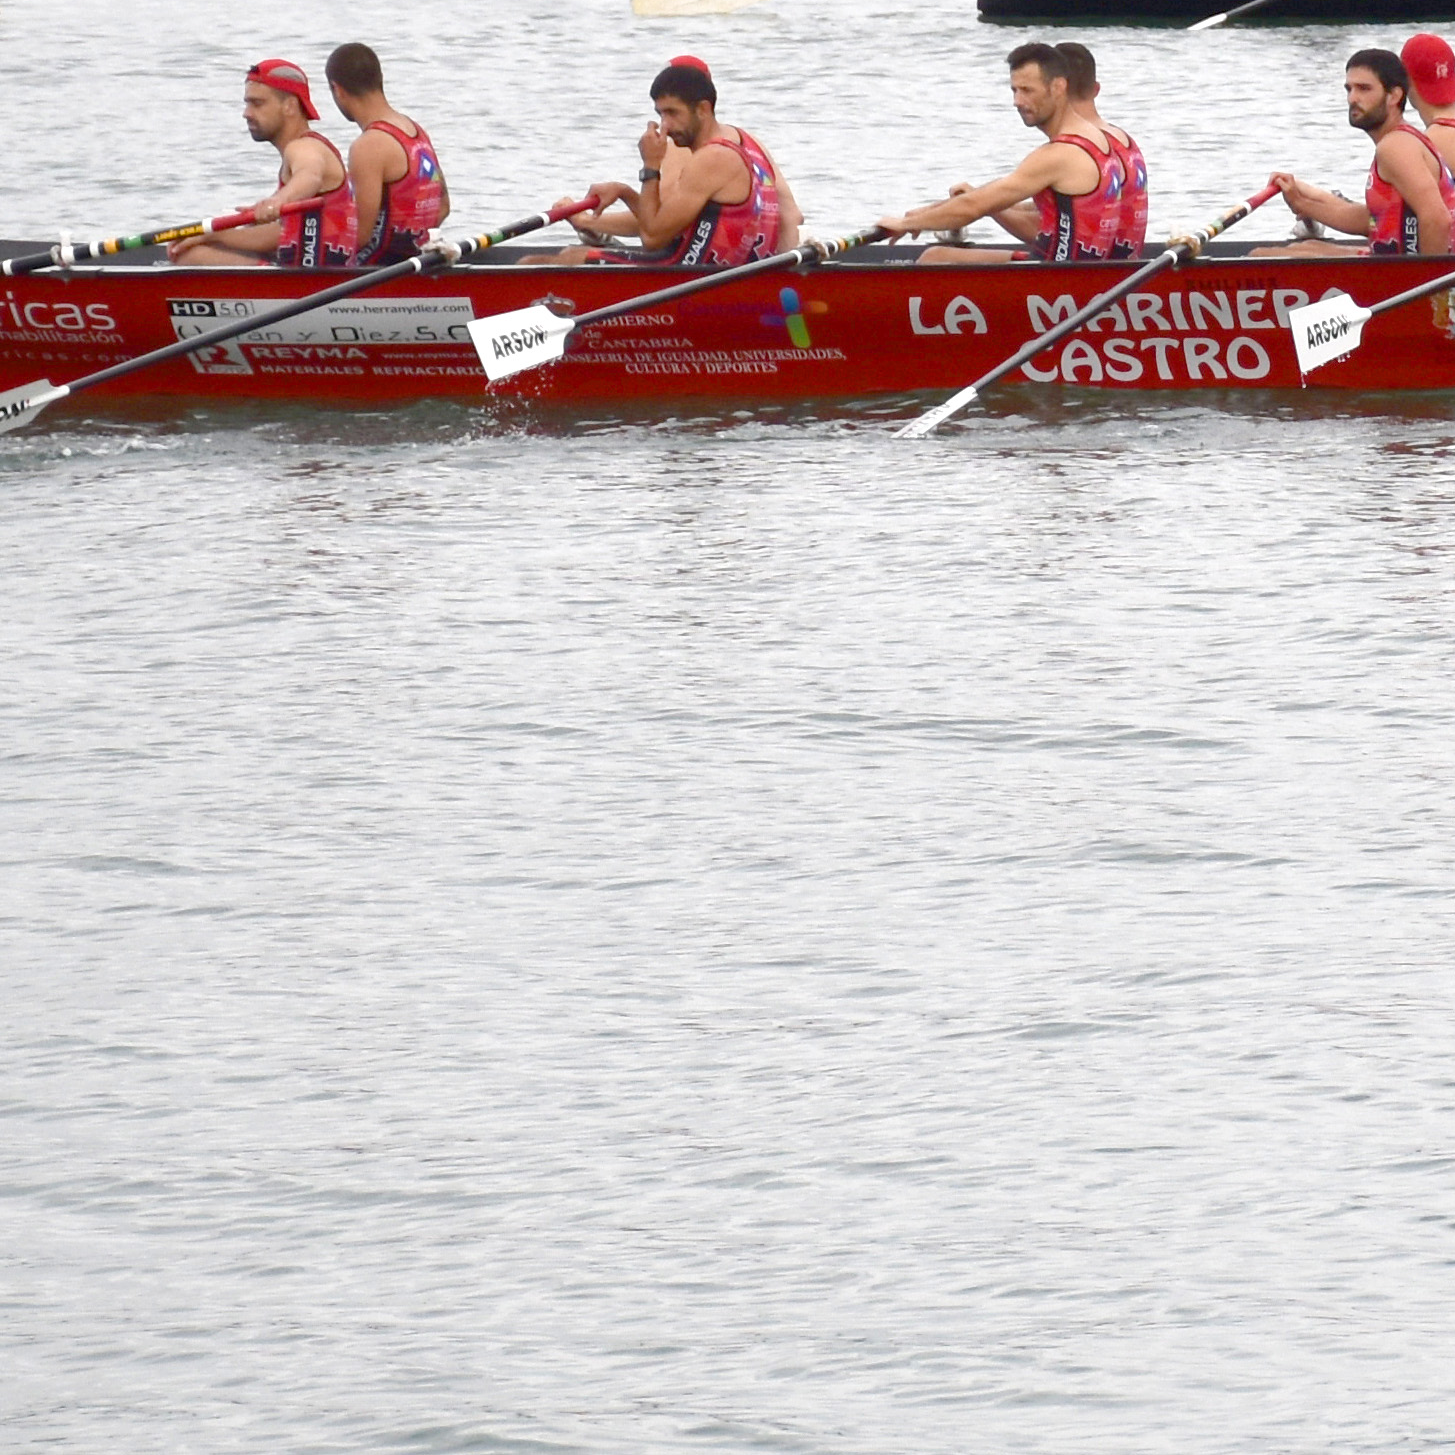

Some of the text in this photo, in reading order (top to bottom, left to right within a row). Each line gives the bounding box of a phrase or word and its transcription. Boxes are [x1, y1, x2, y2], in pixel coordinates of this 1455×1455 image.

[172, 303, 212, 315] HD
[908, 287, 1352, 335] LA MARINER
[585, 314, 674, 328] OBIERNO
[251, 347, 478, 360] REYMA www.reyma.co
[1019, 336, 1271, 383] CASTRO
[260, 365, 364, 375] MATERIALES
[625, 363, 690, 374] CULTURA
[706, 361, 778, 373] DEPORTES
